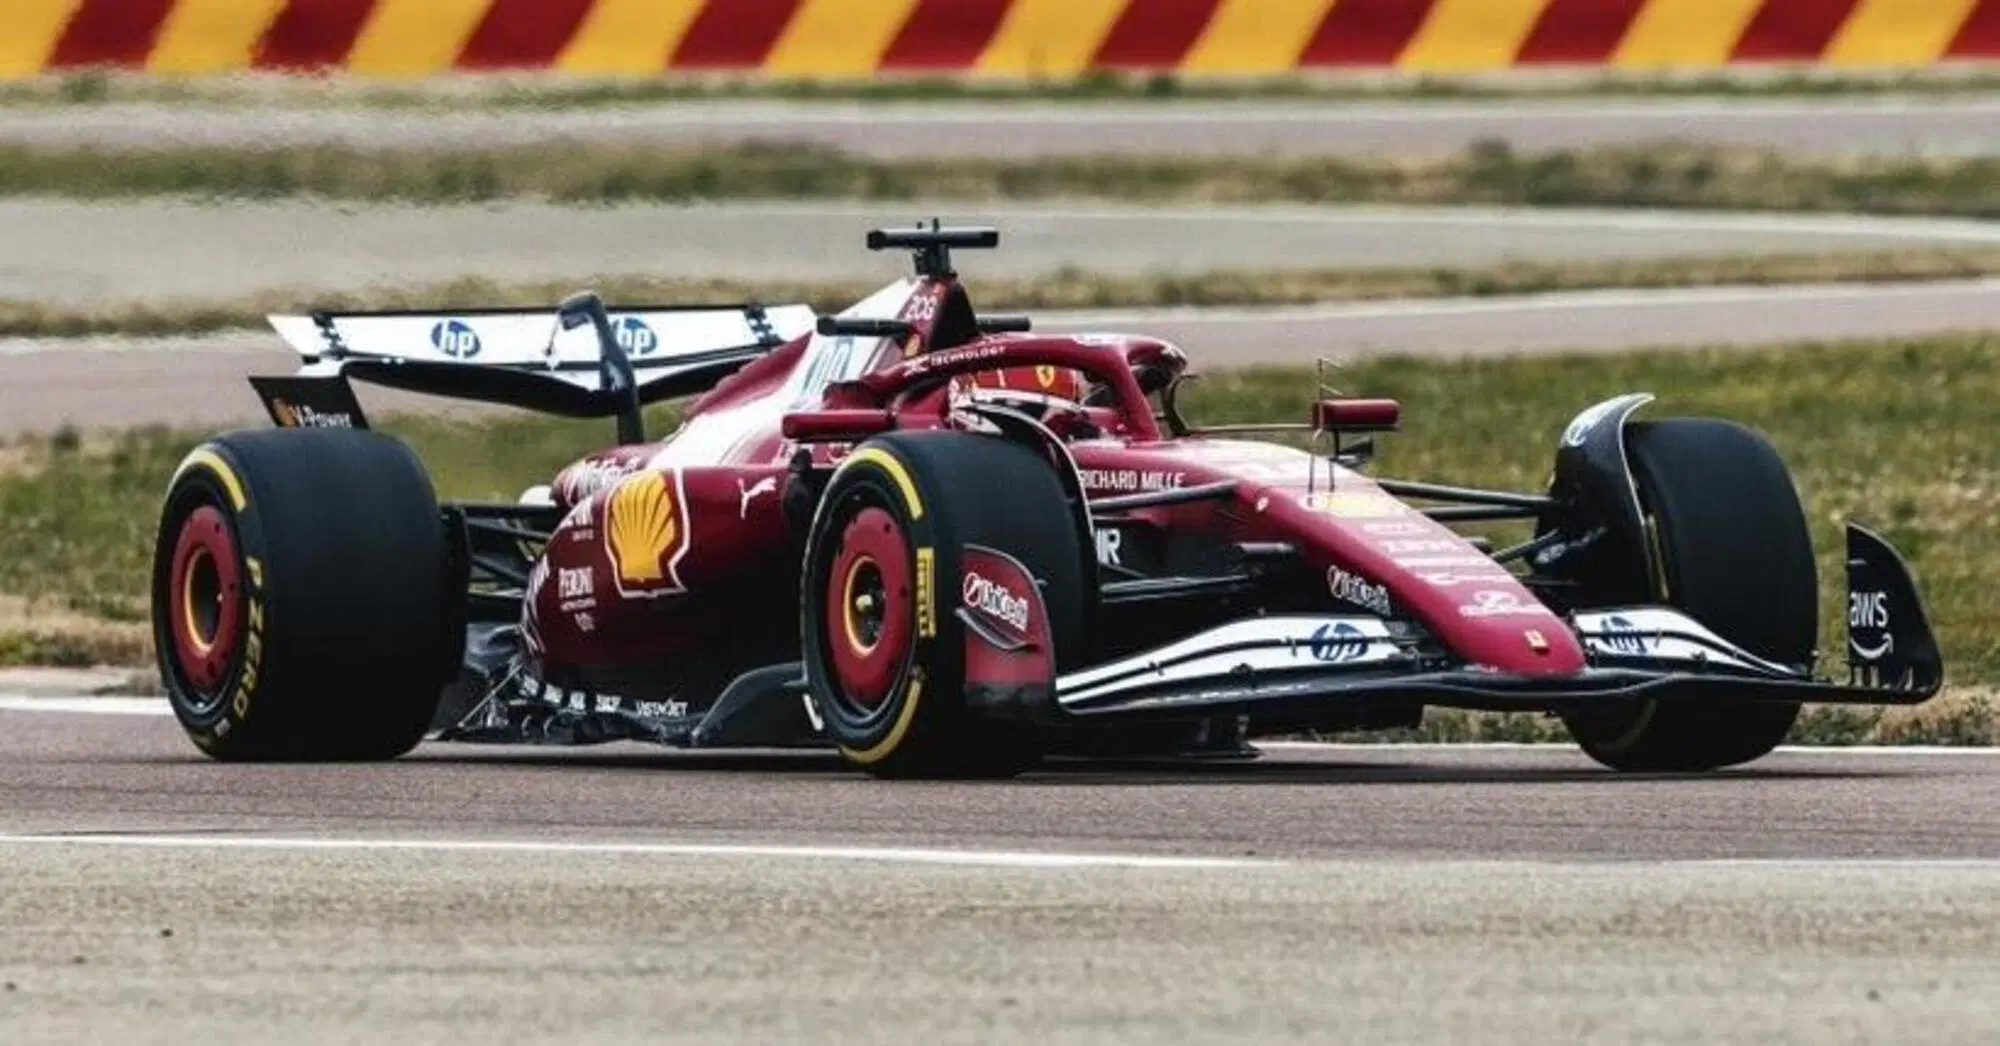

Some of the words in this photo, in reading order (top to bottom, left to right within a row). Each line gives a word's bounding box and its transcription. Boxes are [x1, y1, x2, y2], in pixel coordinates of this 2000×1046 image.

[438, 318, 478, 359] hp
[614, 316, 653, 357] hp
[1080, 469, 1138, 490] RICHARD
[233, 596, 264, 719] ZERO
[1316, 621, 1364, 662] hp
